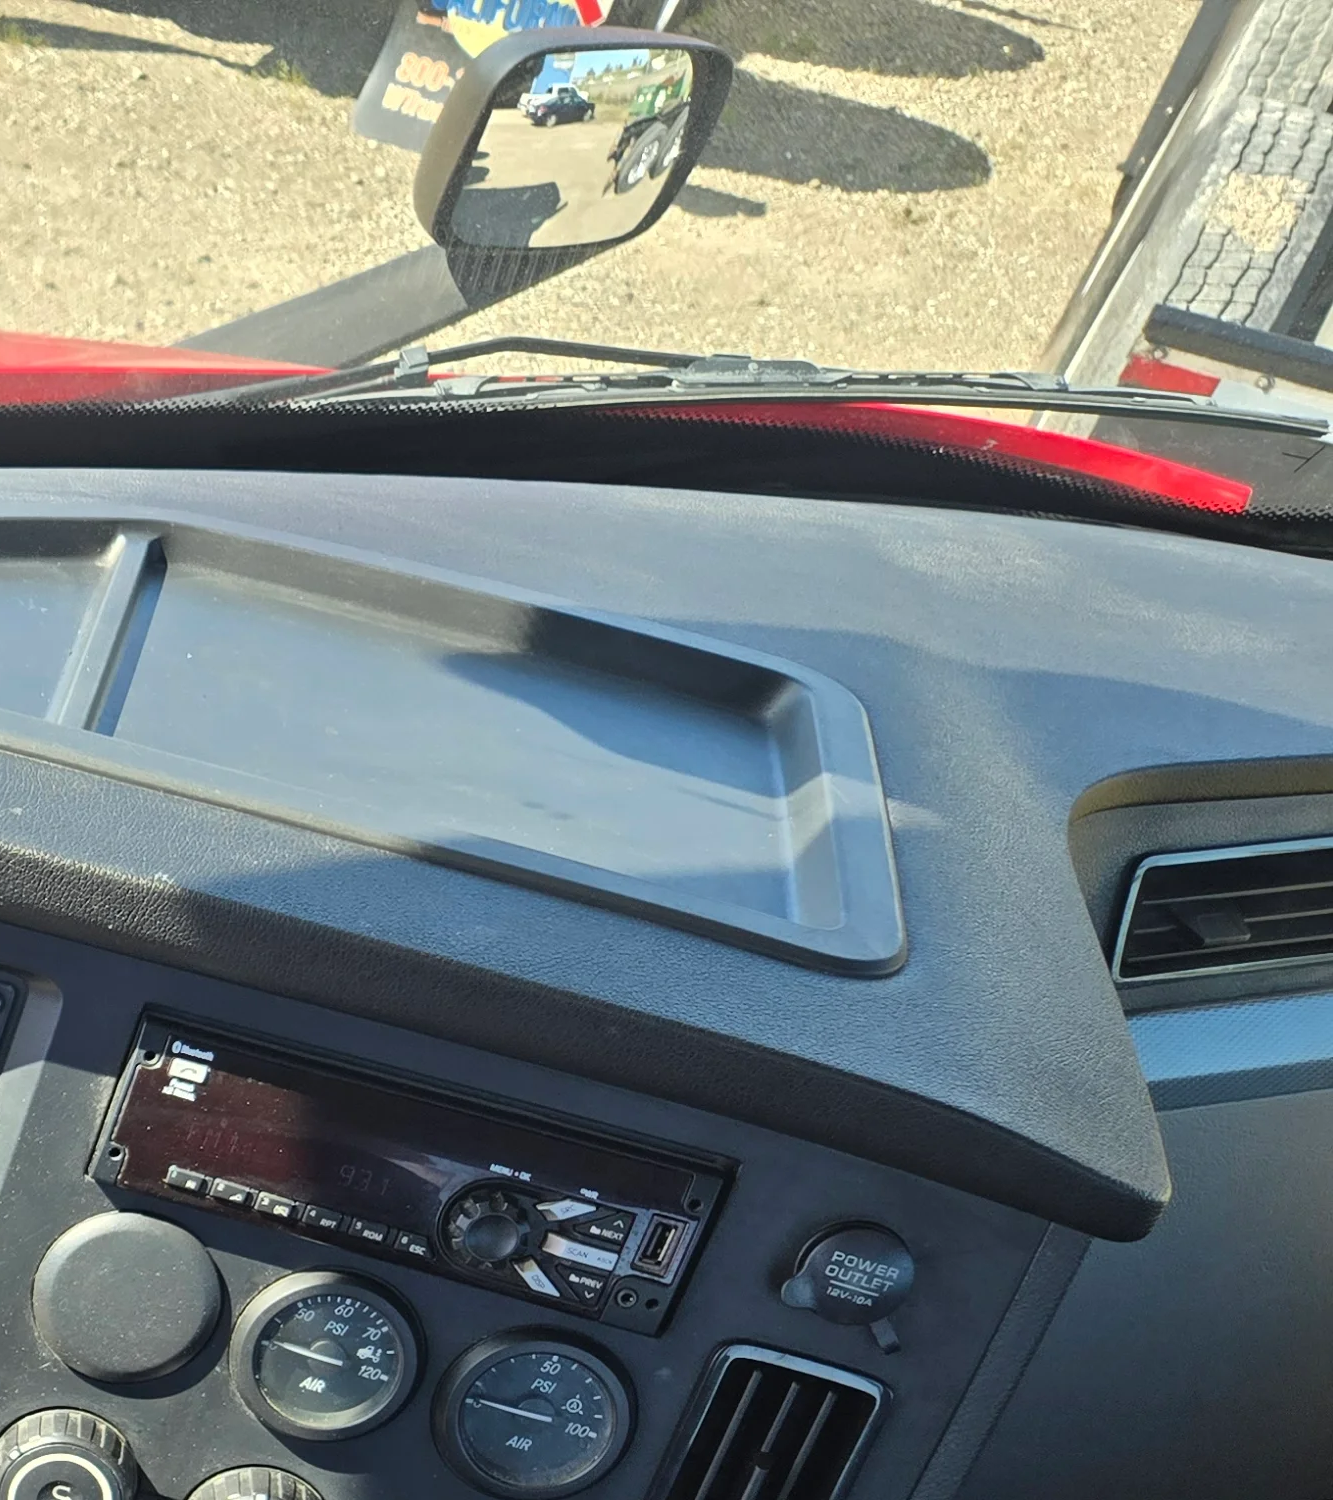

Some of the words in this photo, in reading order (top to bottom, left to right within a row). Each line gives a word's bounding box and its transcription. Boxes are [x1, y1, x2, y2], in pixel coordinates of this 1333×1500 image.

[601, 1228, 625, 1241] NEXT
[565, 1247, 589, 1259] SCAN
[832, 1250, 901, 1280] POWER
[579, 1276, 604, 1290] PREV
[824, 1264, 895, 1293] OUTLET
[826, 1286, 873, 1307] 12V-10A
[334, 1304, 355, 1320] 60
[324, 1320, 349, 1337] PSI
[362, 1327, 382, 1342] 70
[356, 1365, 382, 1381] 120
[540, 1360, 562, 1376] 50
[299, 1375, 327, 1395] AIR
[530, 1377, 558, 1395] PSI
[563, 1421, 590, 1439] 100
[505, 1435, 533, 1452] AIR
